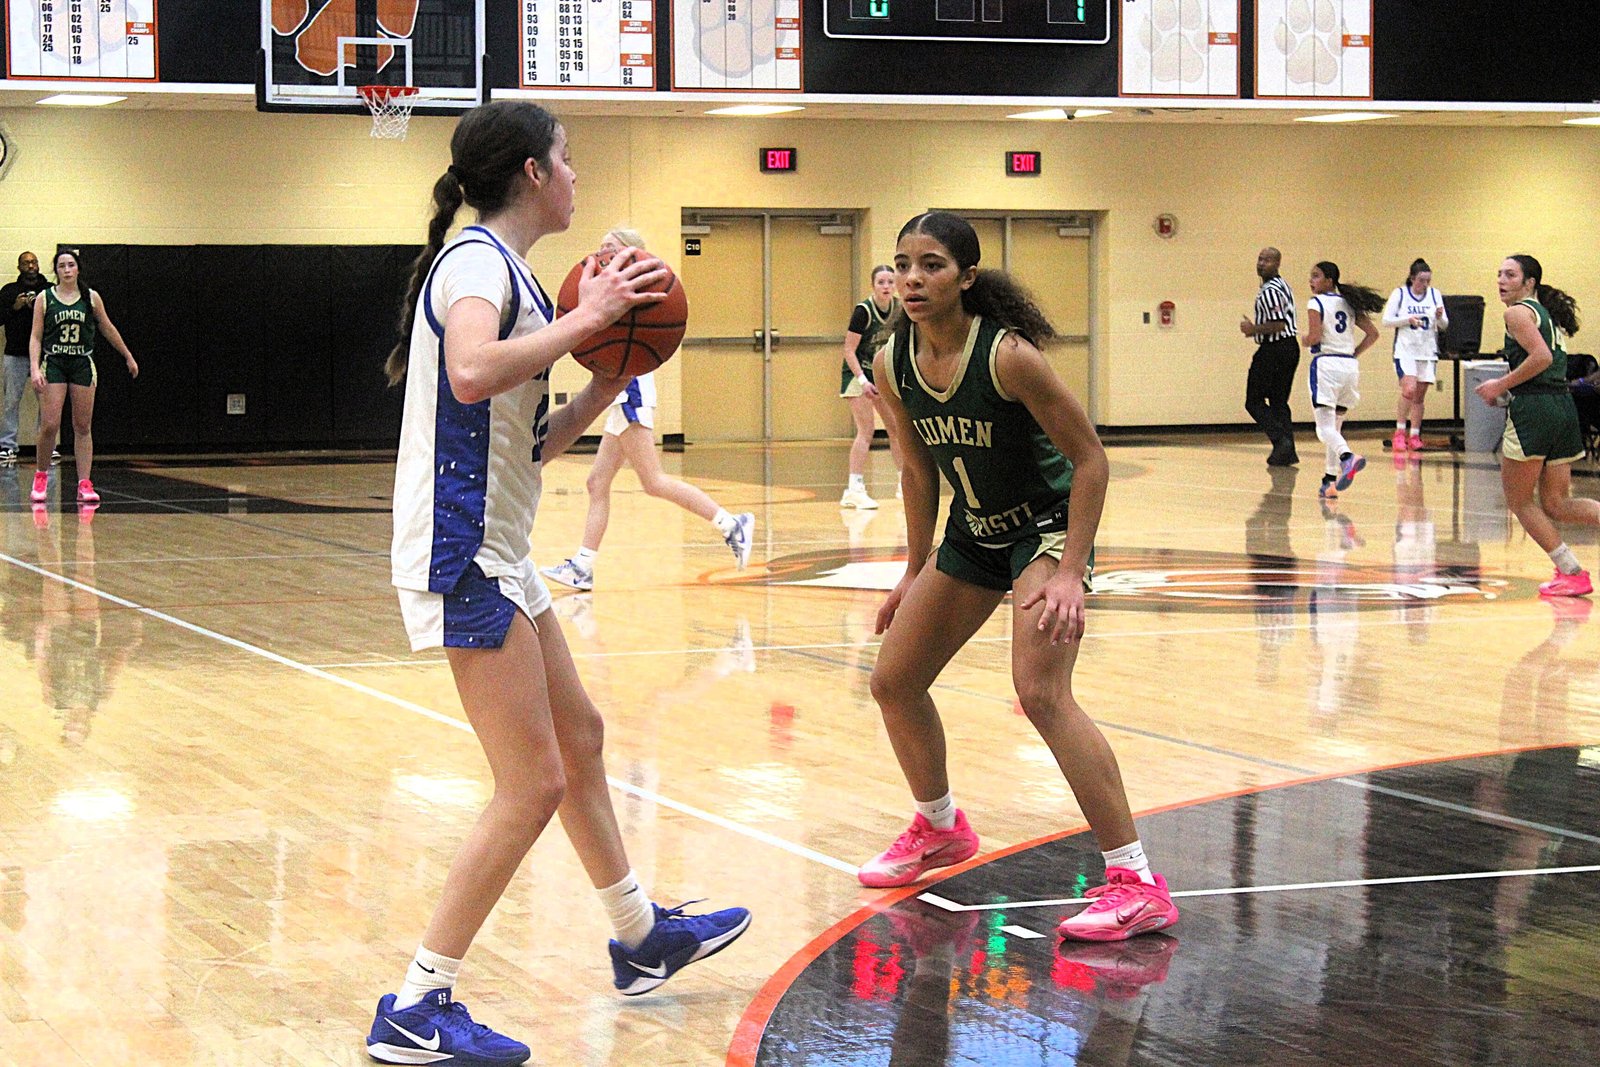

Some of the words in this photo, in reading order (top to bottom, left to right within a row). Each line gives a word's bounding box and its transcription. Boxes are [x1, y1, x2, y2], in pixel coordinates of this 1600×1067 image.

[42, 3, 52, 11] 06
[72, 4, 80, 12] 01
[101, 4, 110, 12] 25
[527, 3, 536, 12] 91
[560, 4, 569, 13] 88
[573, 4, 581, 13] 12
[43, 14, 52, 22] 16
[71, 14, 81, 23] 02
[527, 15, 537, 24] 93
[560, 16, 569, 24] 90
[573, 16, 582, 24] 13
[44, 24, 51, 33] 17
[72, 25, 82, 33] 05
[527, 26, 538, 35] 09
[560, 27, 569, 36] 91
[573, 27, 581, 35] 14
[43, 34, 53, 42] 24
[72, 35, 81, 43] 16
[128, 37, 138, 45] 25
[528, 38, 537, 46] 10
[43, 43, 53, 52] 25
[560, 39, 570, 48] 93
[573, 39, 582, 48] 15
[73, 46, 81, 54] 17
[528, 50, 535, 58] 11
[560, 51, 570, 59] 95
[574, 51, 583, 60] 16
[73, 56, 81, 64] 18
[528, 61, 536, 70] 14
[560, 62, 569, 71] 97
[574, 62, 583, 71] 19
[528, 72, 537, 80] 15
[560, 74, 570, 82] 04
[623, 77, 632, 85] 84
[767, 150, 790, 168] EXIT
[1012, 154, 1035, 172] EXIT
[54, 310, 86, 324] LUMEN
[1335, 311, 1347, 333] 3
[59, 324, 81, 343] 33
[51, 344, 85, 355] CHRISTI
[912, 415, 993, 448] LUMEN
[952, 456, 982, 509] 1
